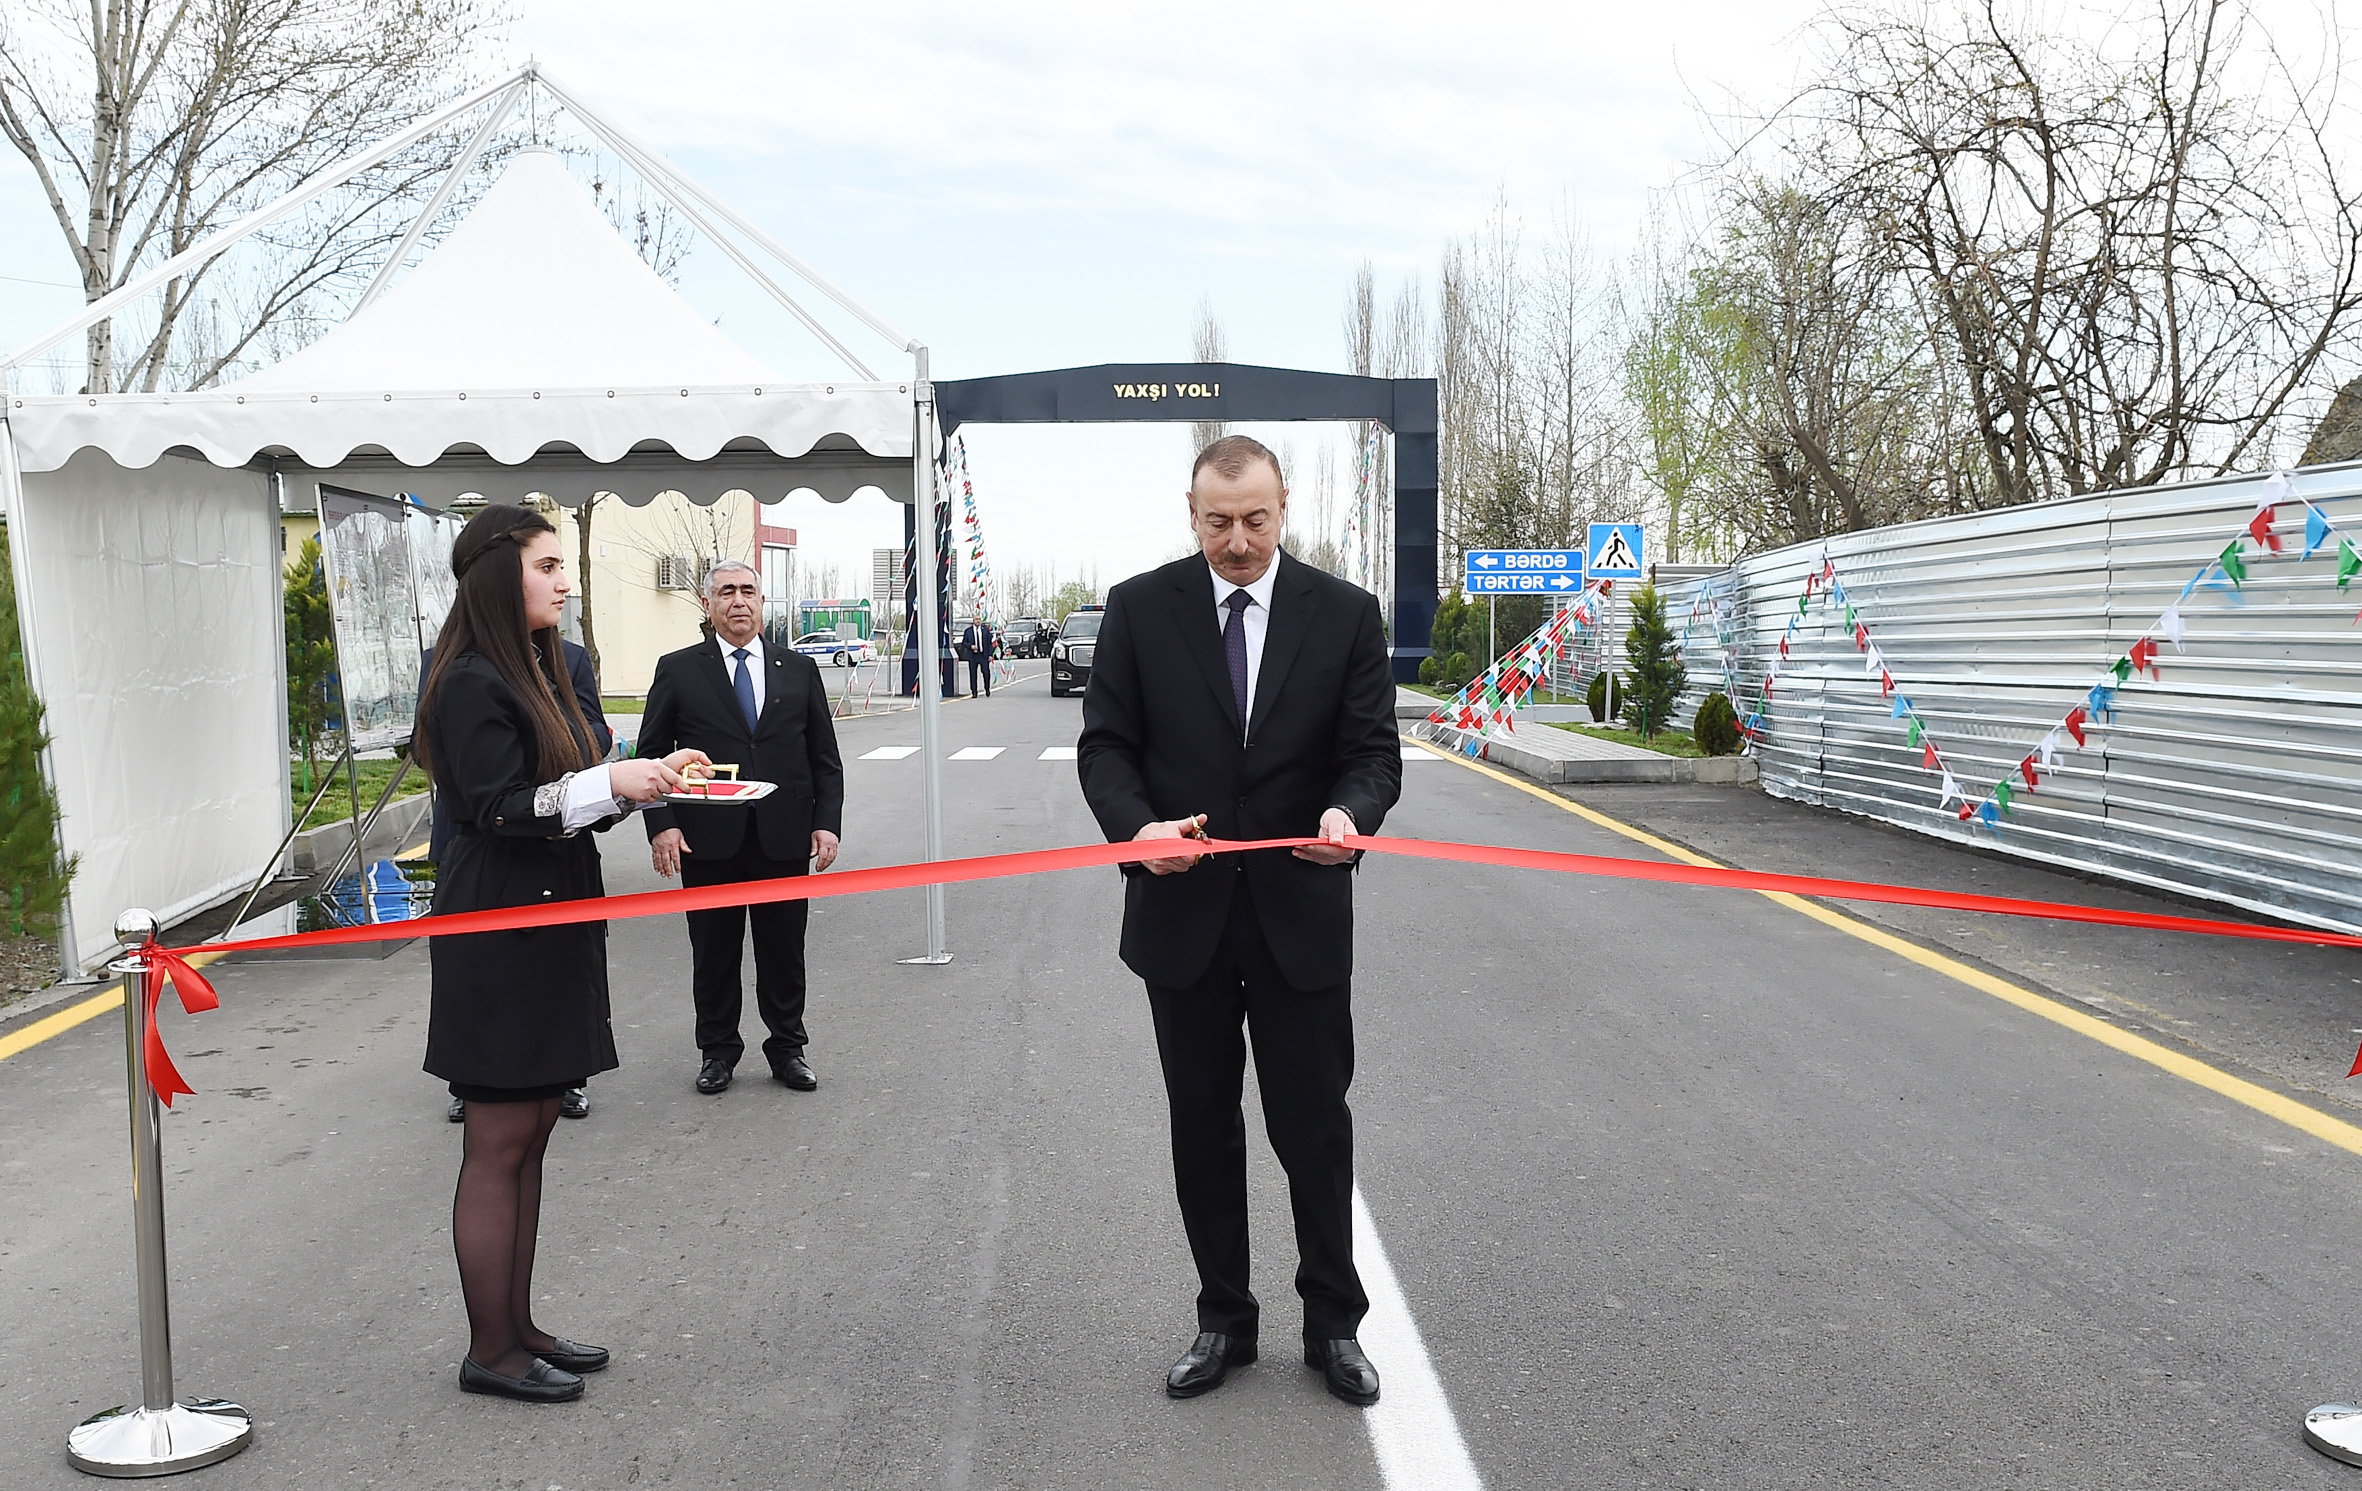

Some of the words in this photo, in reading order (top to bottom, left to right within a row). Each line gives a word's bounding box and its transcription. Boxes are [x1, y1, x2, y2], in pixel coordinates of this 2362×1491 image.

[1113, 383, 1167, 401] YAXŞI
[1174, 383, 1220, 398] YOL!
[1505, 554, 1568, 569] BƏRDƏ
[1473, 575, 1545, 590] TƏRTƏR
